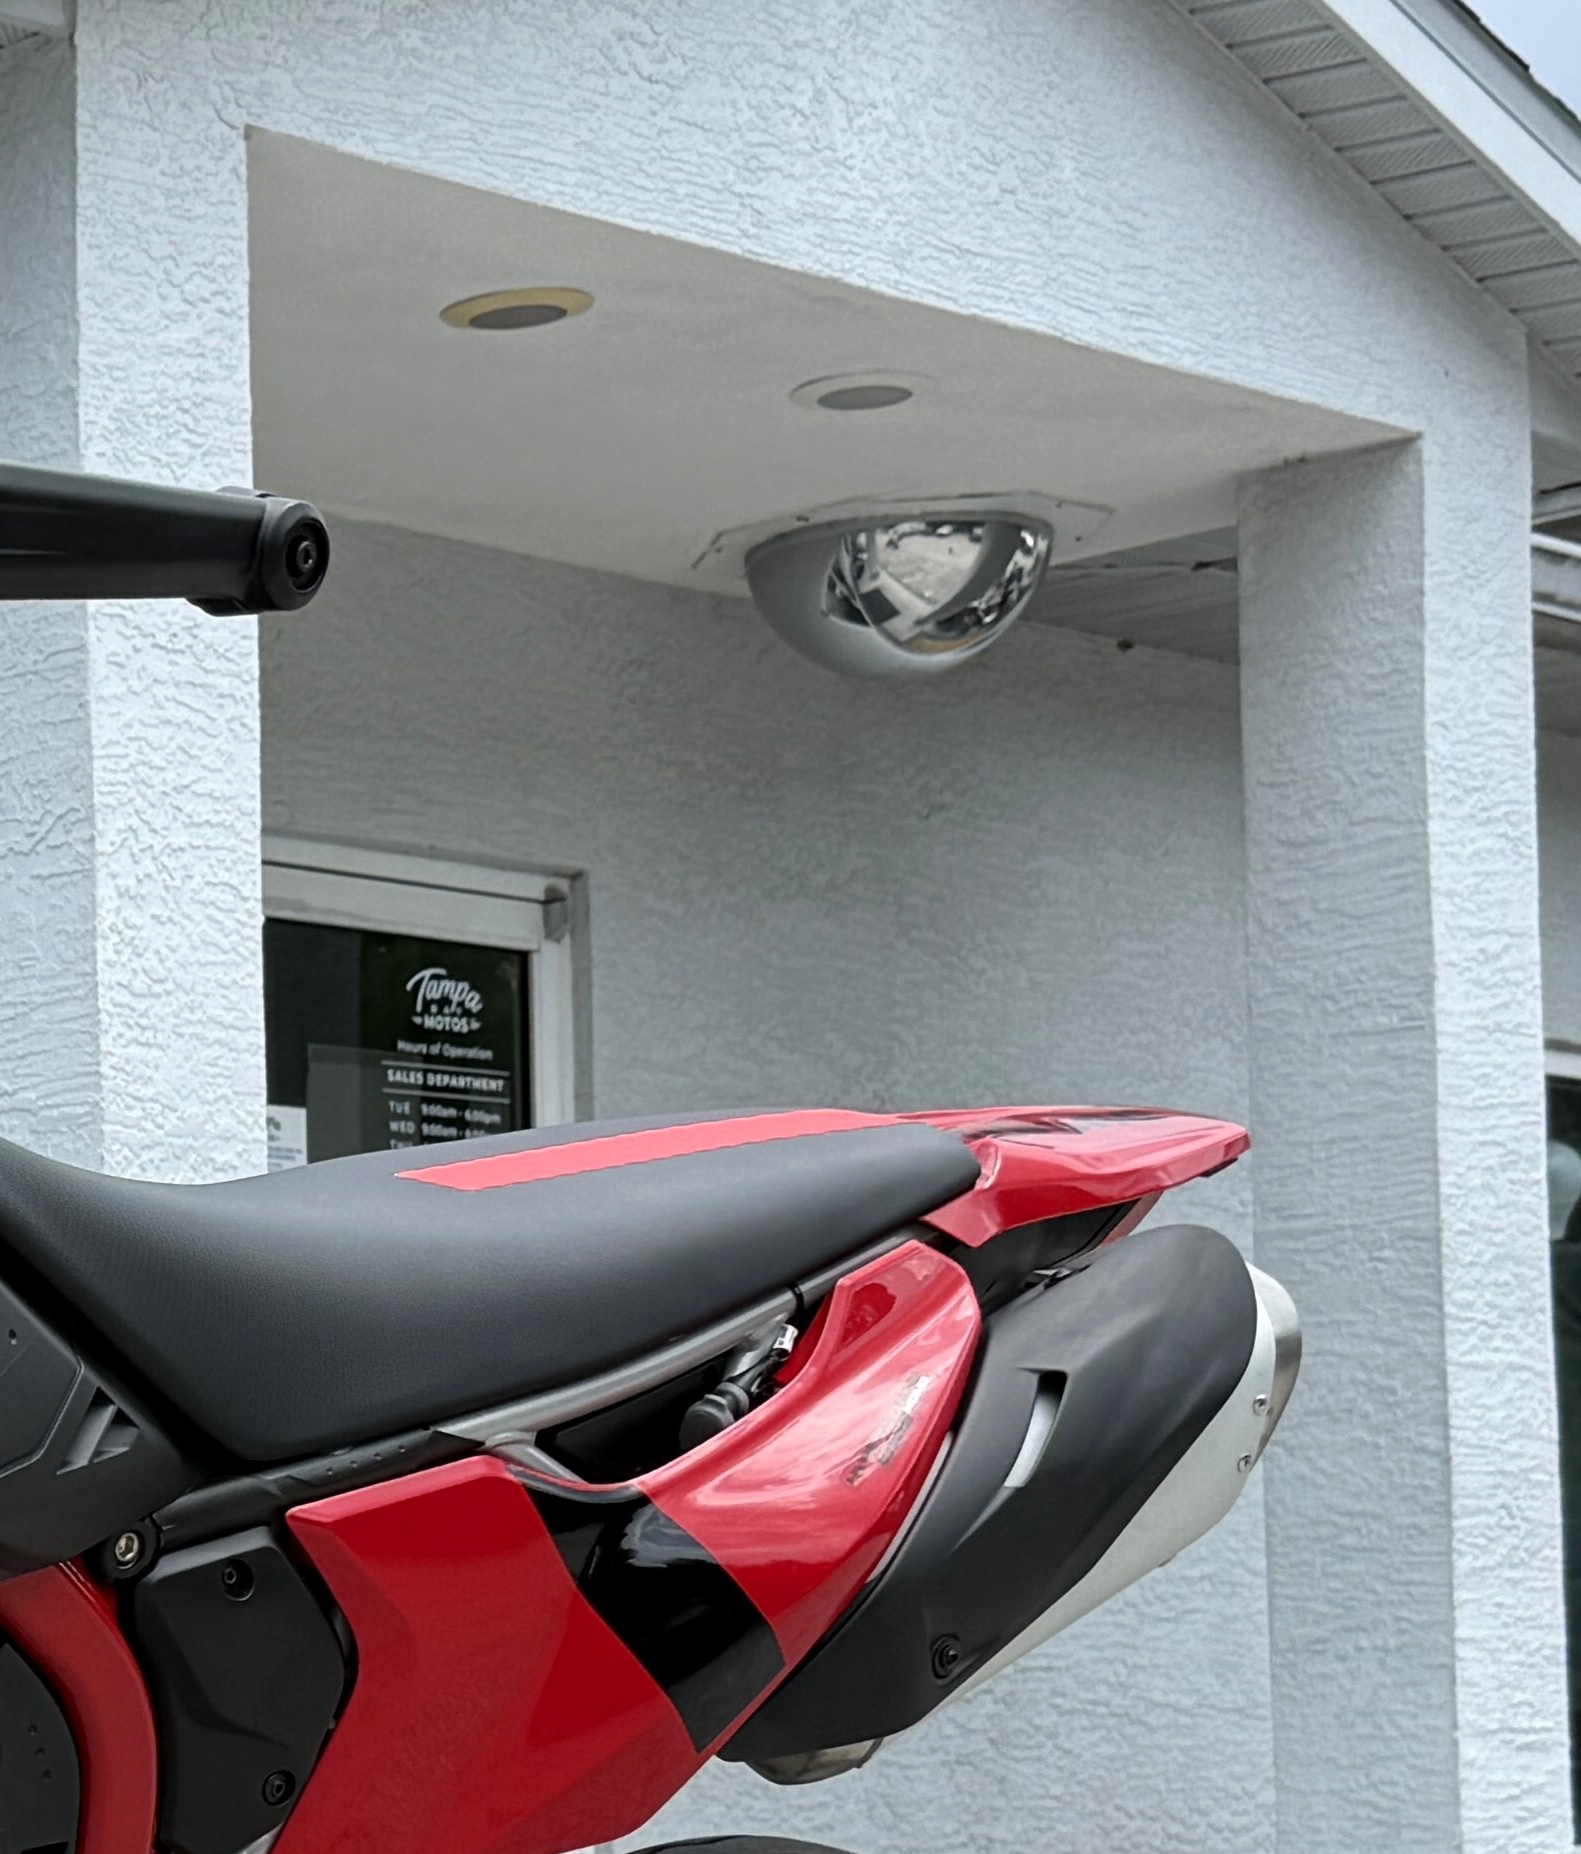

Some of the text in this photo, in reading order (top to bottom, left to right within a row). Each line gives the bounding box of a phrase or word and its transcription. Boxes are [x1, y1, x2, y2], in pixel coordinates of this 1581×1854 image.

[405, 967, 483, 1013] Tampa
[423, 1014, 469, 1033] MOTOS
[386, 1068, 505, 1092] SALES DEPARTMENT
[389, 1100, 411, 1115] TUE
[389, 1121, 416, 1135] WED
